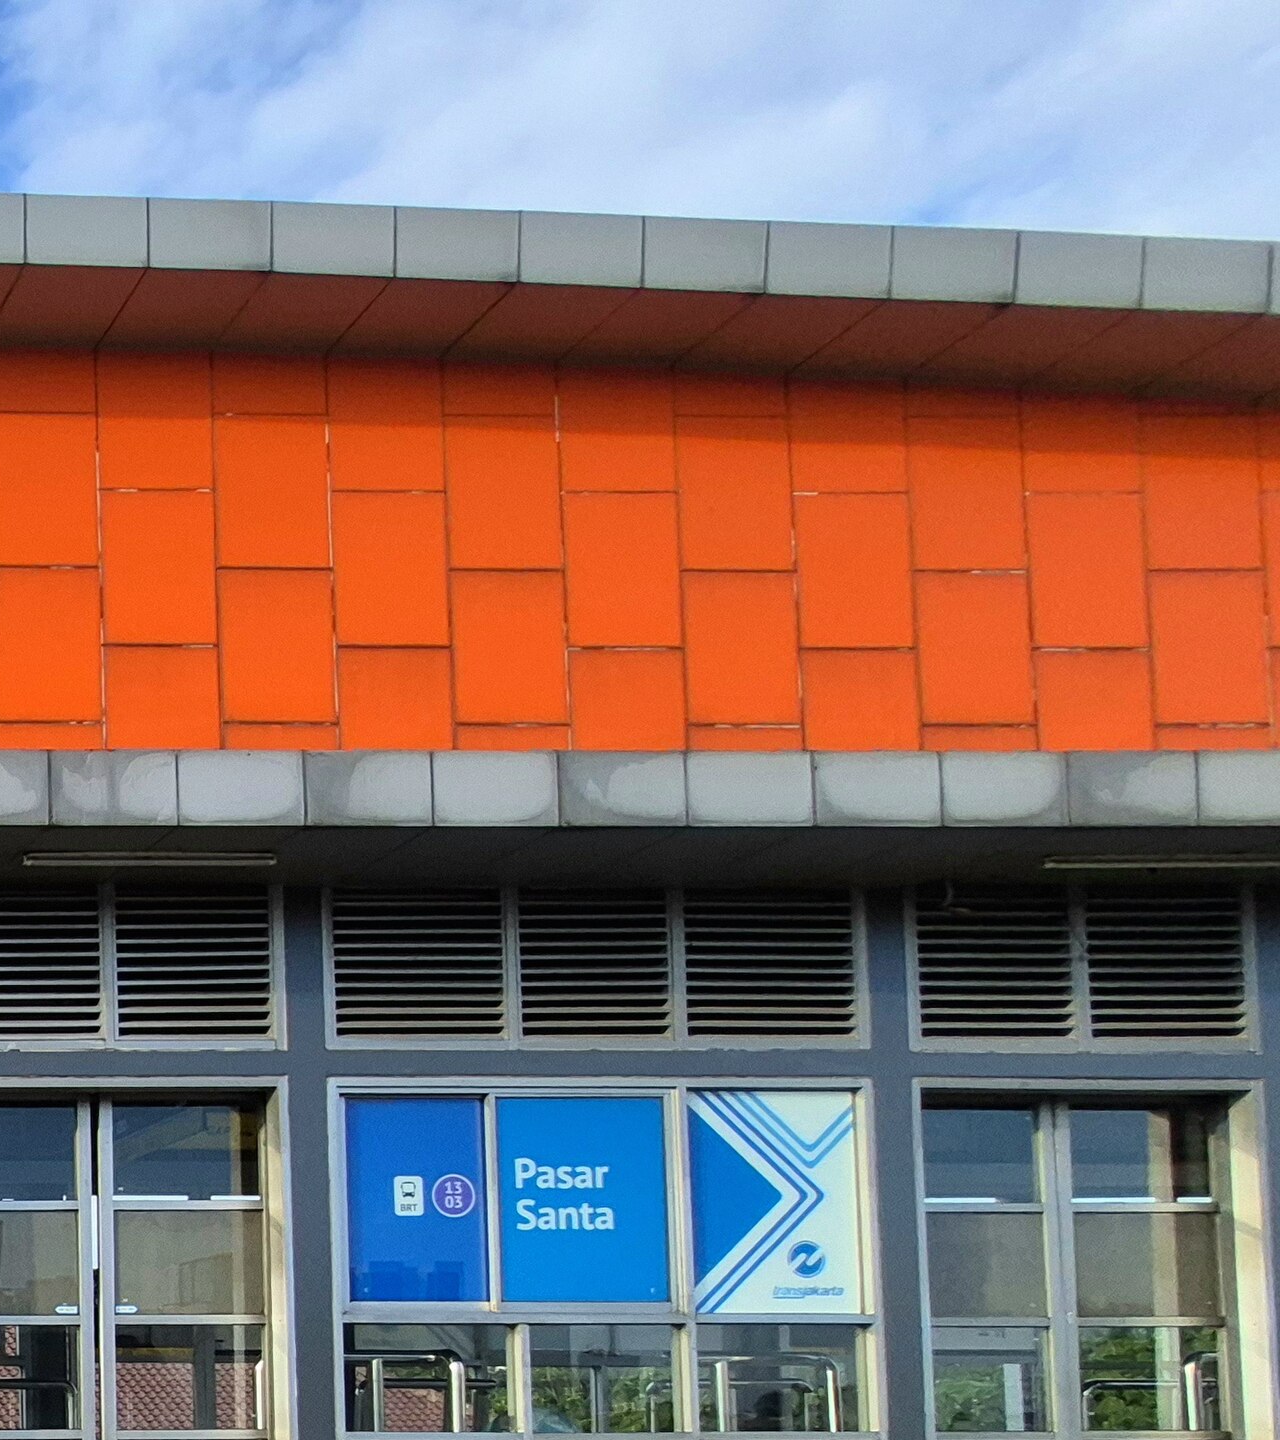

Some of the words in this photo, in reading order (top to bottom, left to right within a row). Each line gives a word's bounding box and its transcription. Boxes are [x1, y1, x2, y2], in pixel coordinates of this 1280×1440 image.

[514, 1157, 609, 1189] Pasar
[444, 1181, 462, 1194] 13
[400, 1203, 418, 1212] BRT
[444, 1195, 463, 1209] 03
[516, 1198, 615, 1231] Santa
